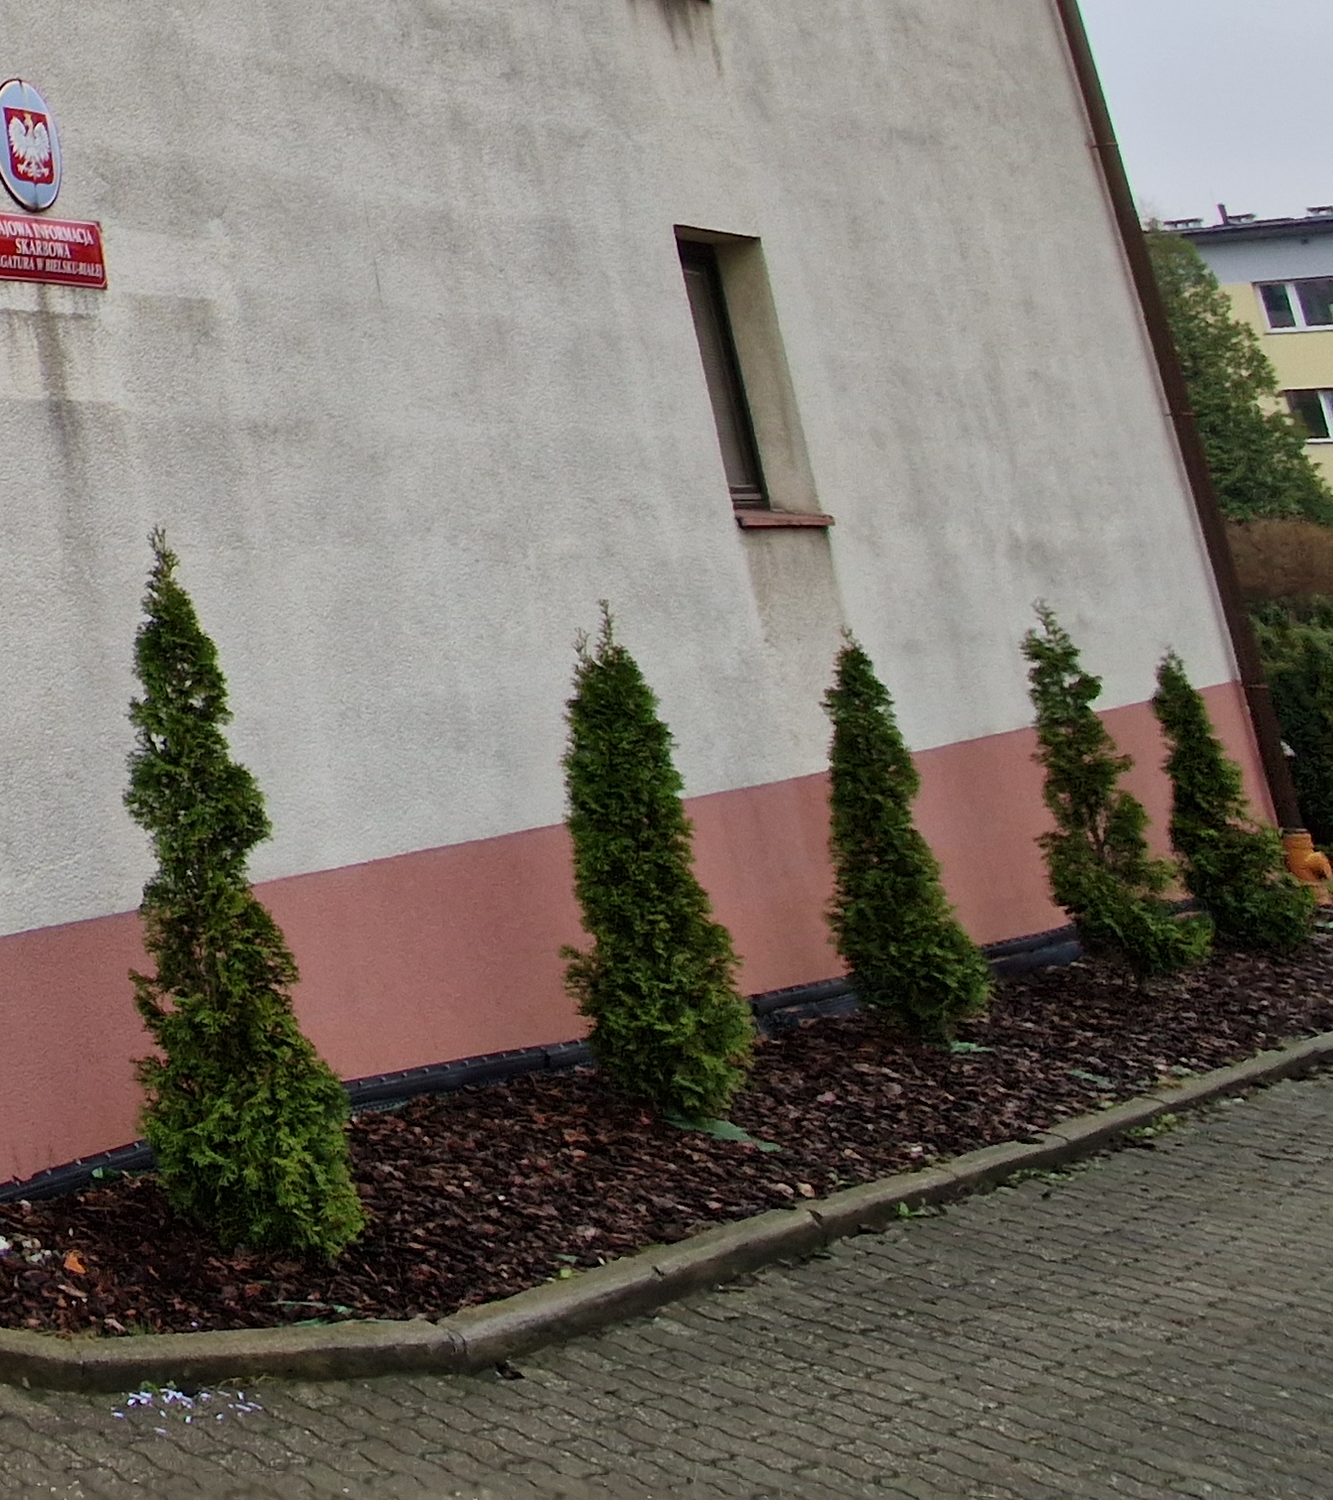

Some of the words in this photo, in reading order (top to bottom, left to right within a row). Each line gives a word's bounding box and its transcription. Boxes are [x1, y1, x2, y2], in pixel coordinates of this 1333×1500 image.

[32, 223, 94, 246] INFORMACJA
[15, 238, 71, 259] SKARBOWA
[36, 258, 45, 271] W
